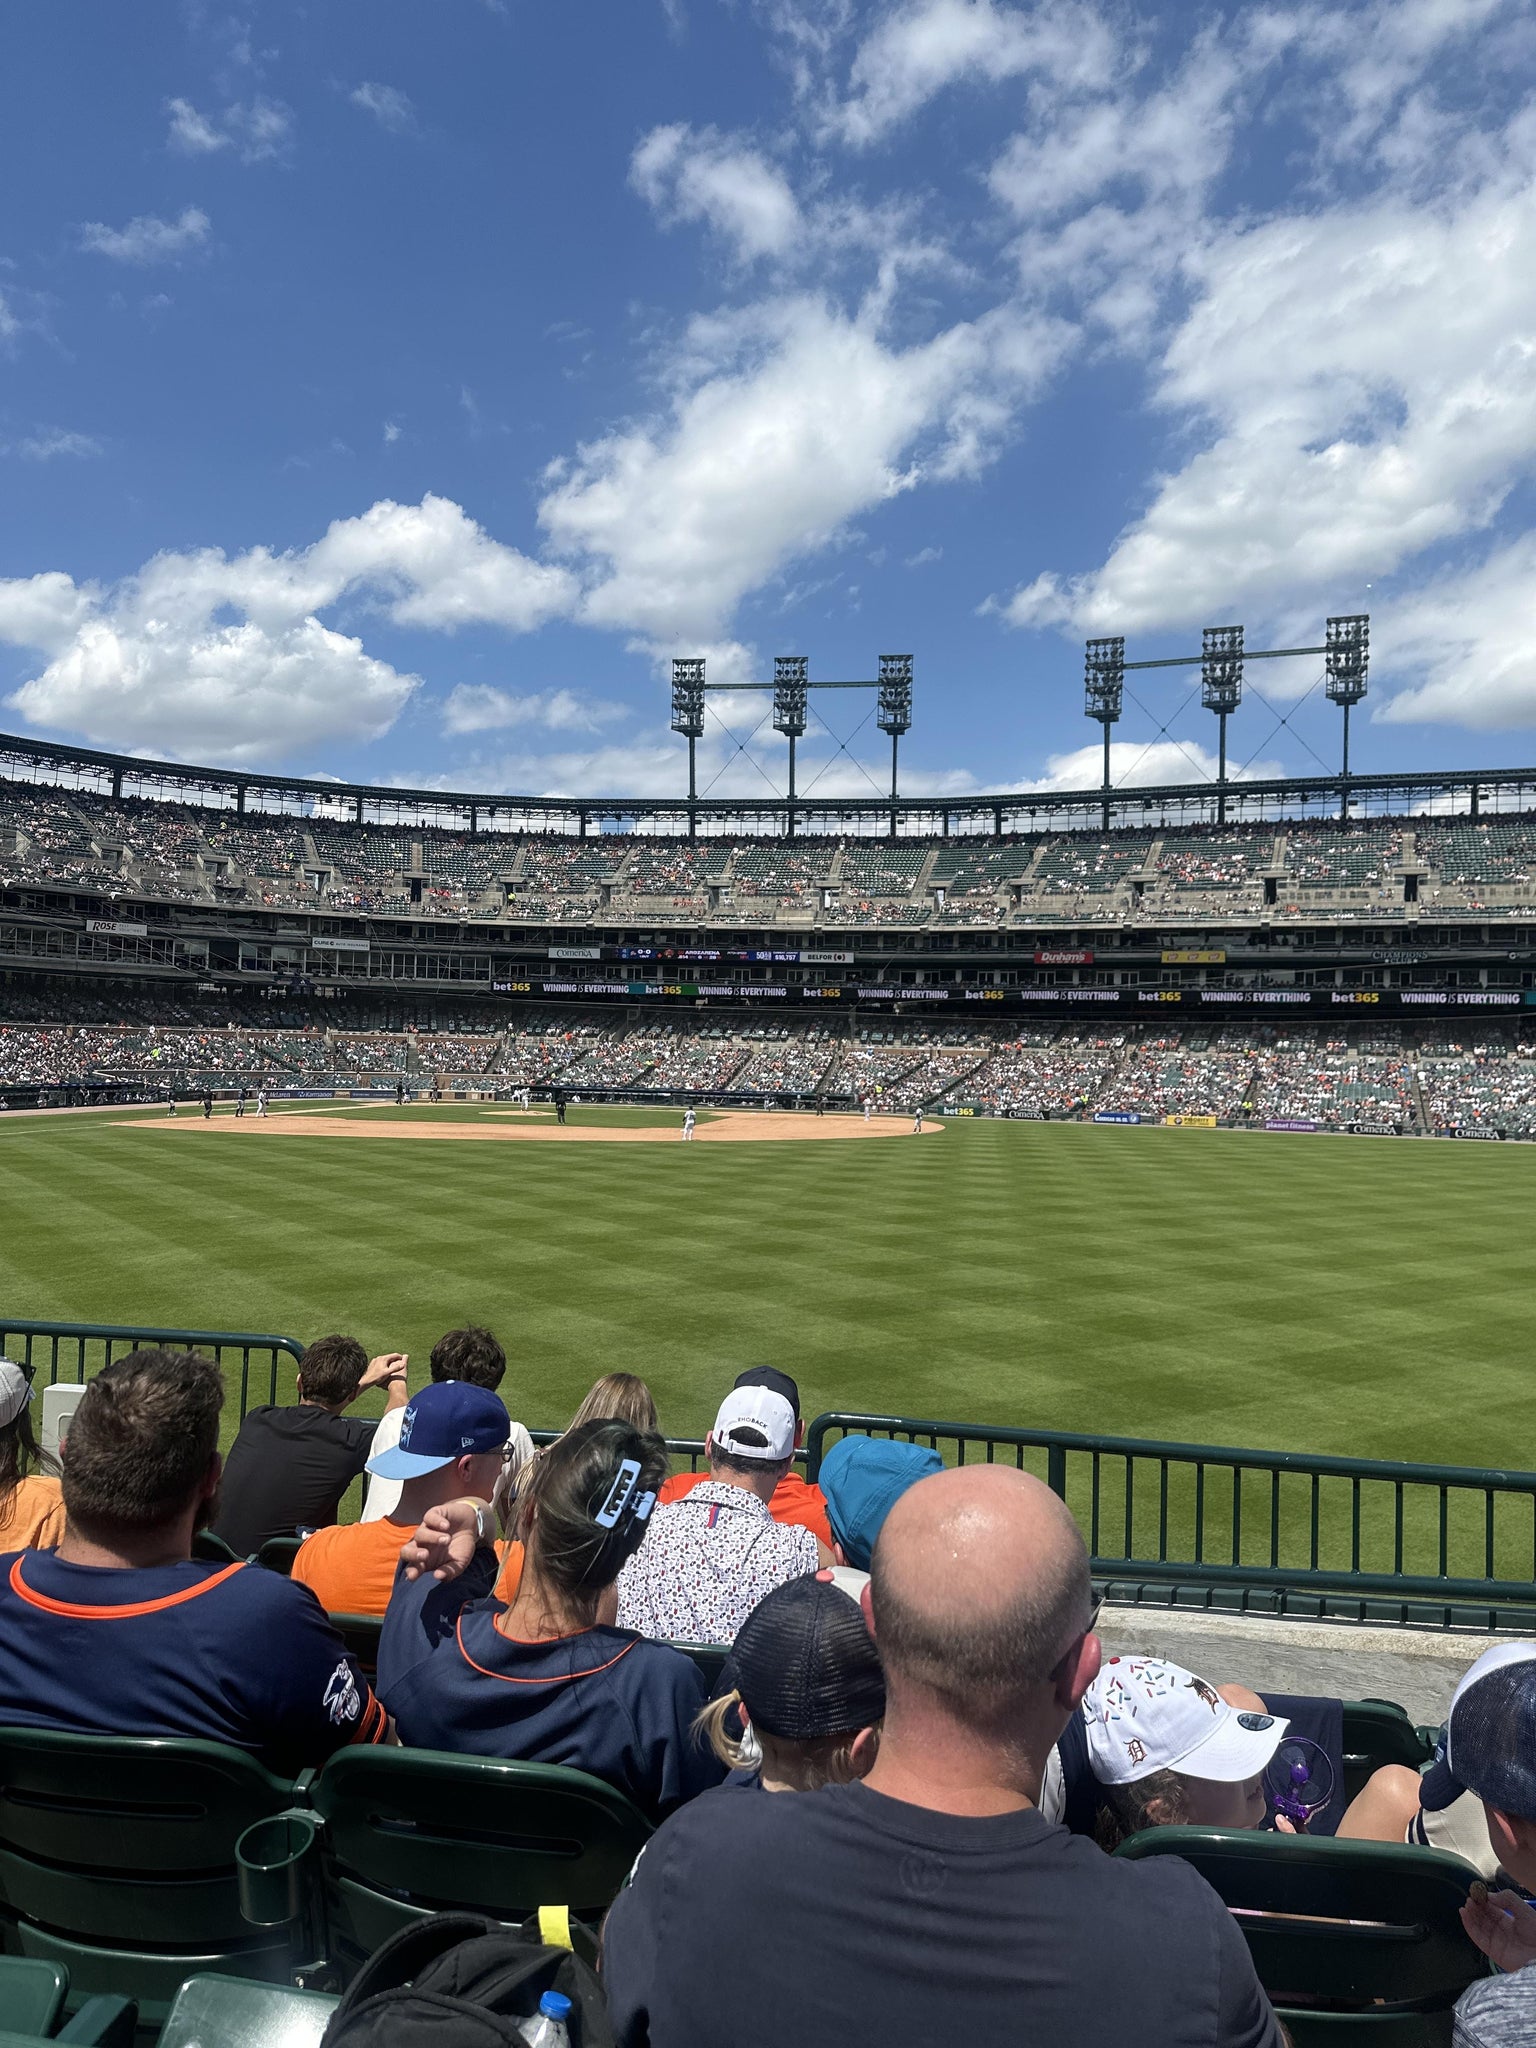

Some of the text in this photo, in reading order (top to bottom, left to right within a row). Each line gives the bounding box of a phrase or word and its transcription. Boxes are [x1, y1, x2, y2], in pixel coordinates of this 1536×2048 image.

[93, 921, 117, 931] ROSE
[1041, 952, 1086, 961] Dunham's
[1372, 950, 1429, 960] CHAMPIONS
[493, 982, 531, 992] bet365
[543, 983, 630, 994] WINNING IS EVERYTHING
[645, 985, 682, 995] bet365
[698, 986, 787, 996] WINNING IS EVERYTHING
[803, 987, 841, 997] bet365
[858, 988, 949, 999] WINNING IS EVERYTHING
[965, 990, 1004, 1000] bet365
[1021, 990, 1120, 1001] WINNING IS EVERYTHING
[1138, 991, 1181, 1001] bet365
[1201, 992, 1311, 1003] WINNING IS EVERYTHING
[1331, 992, 1379, 1003] bet365
[1400, 993, 1520, 1004] WINNING IS EVERYTHING
[943, 1107, 974, 1116] bet365
[1265, 1121, 1289, 1129] planet
